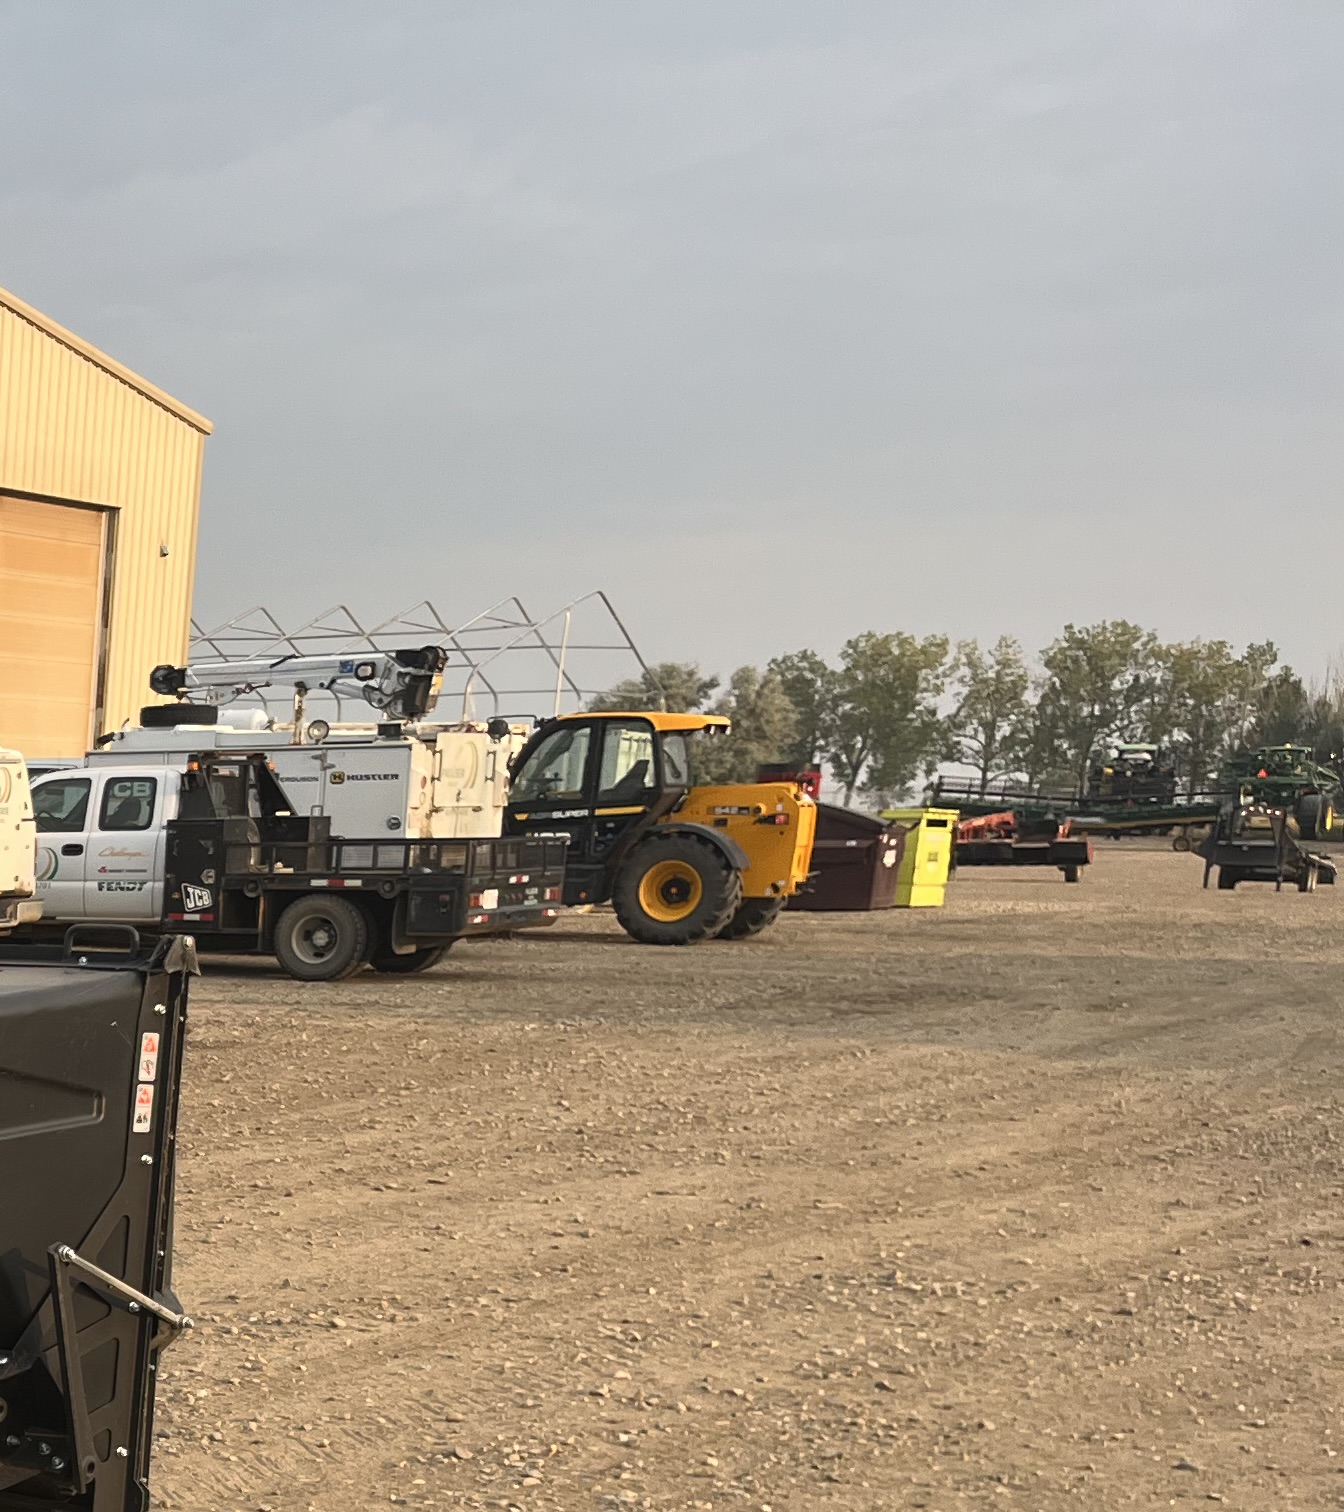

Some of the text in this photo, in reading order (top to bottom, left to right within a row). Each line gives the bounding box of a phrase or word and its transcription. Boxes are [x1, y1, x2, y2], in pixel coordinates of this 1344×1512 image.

[346, 773, 399, 781] HUSTLER
[97, 881, 148, 892] FENDT
[185, 886, 210, 909] JCB
